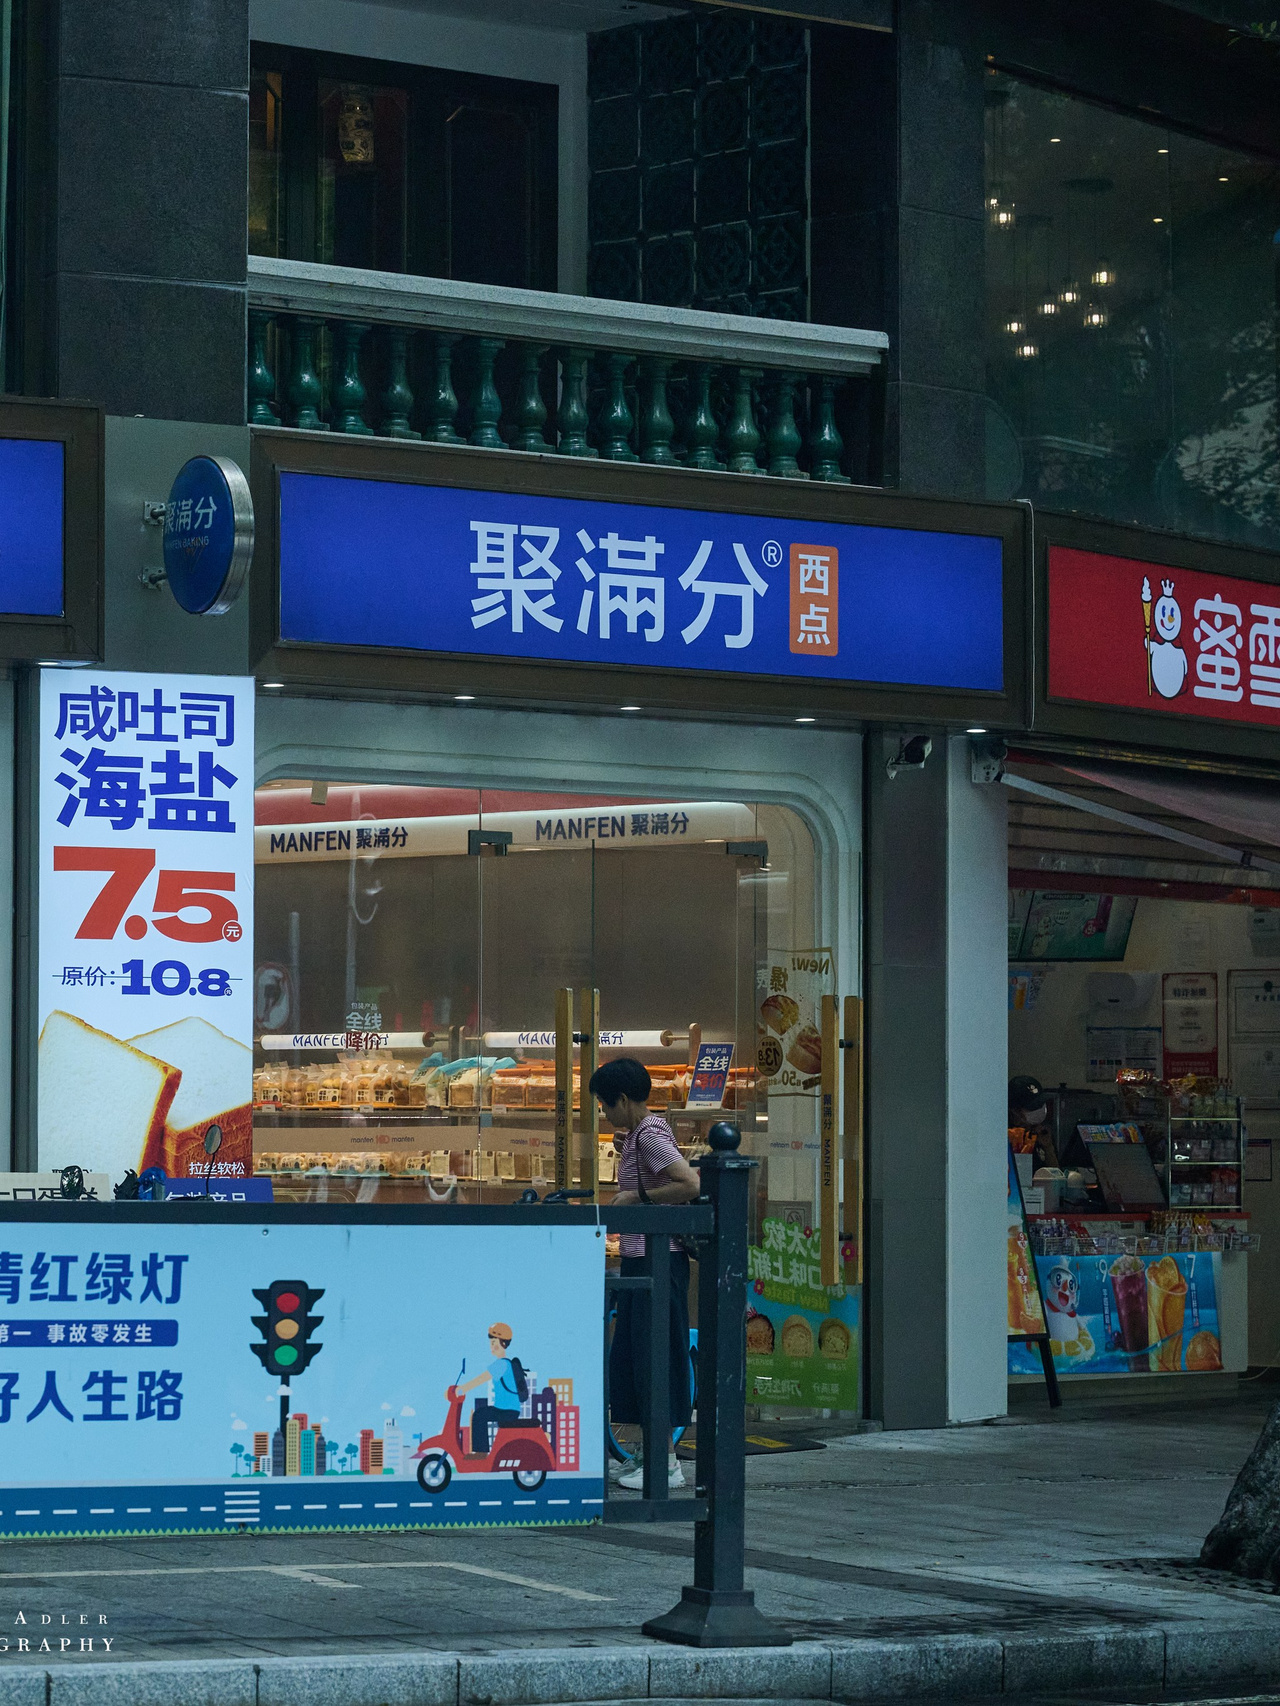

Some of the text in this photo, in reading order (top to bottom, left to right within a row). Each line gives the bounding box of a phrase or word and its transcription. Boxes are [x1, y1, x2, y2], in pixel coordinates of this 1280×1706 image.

[796, 553, 832, 647] 西点
[54, 685, 236, 748] 咸吐司
[54, 748, 239, 834] 海盐
[536, 815, 626, 841] MANFEN
[270, 829, 352, 854] MANFEN
[345, 1011, 382, 1031] 全线
[345, 1031, 381, 1052] 降价
[697, 1056, 729, 1072] 全线
[188, 1161, 246, 1175] 拉丝软松
[46, 1322, 153, 1345] 事故零发生
